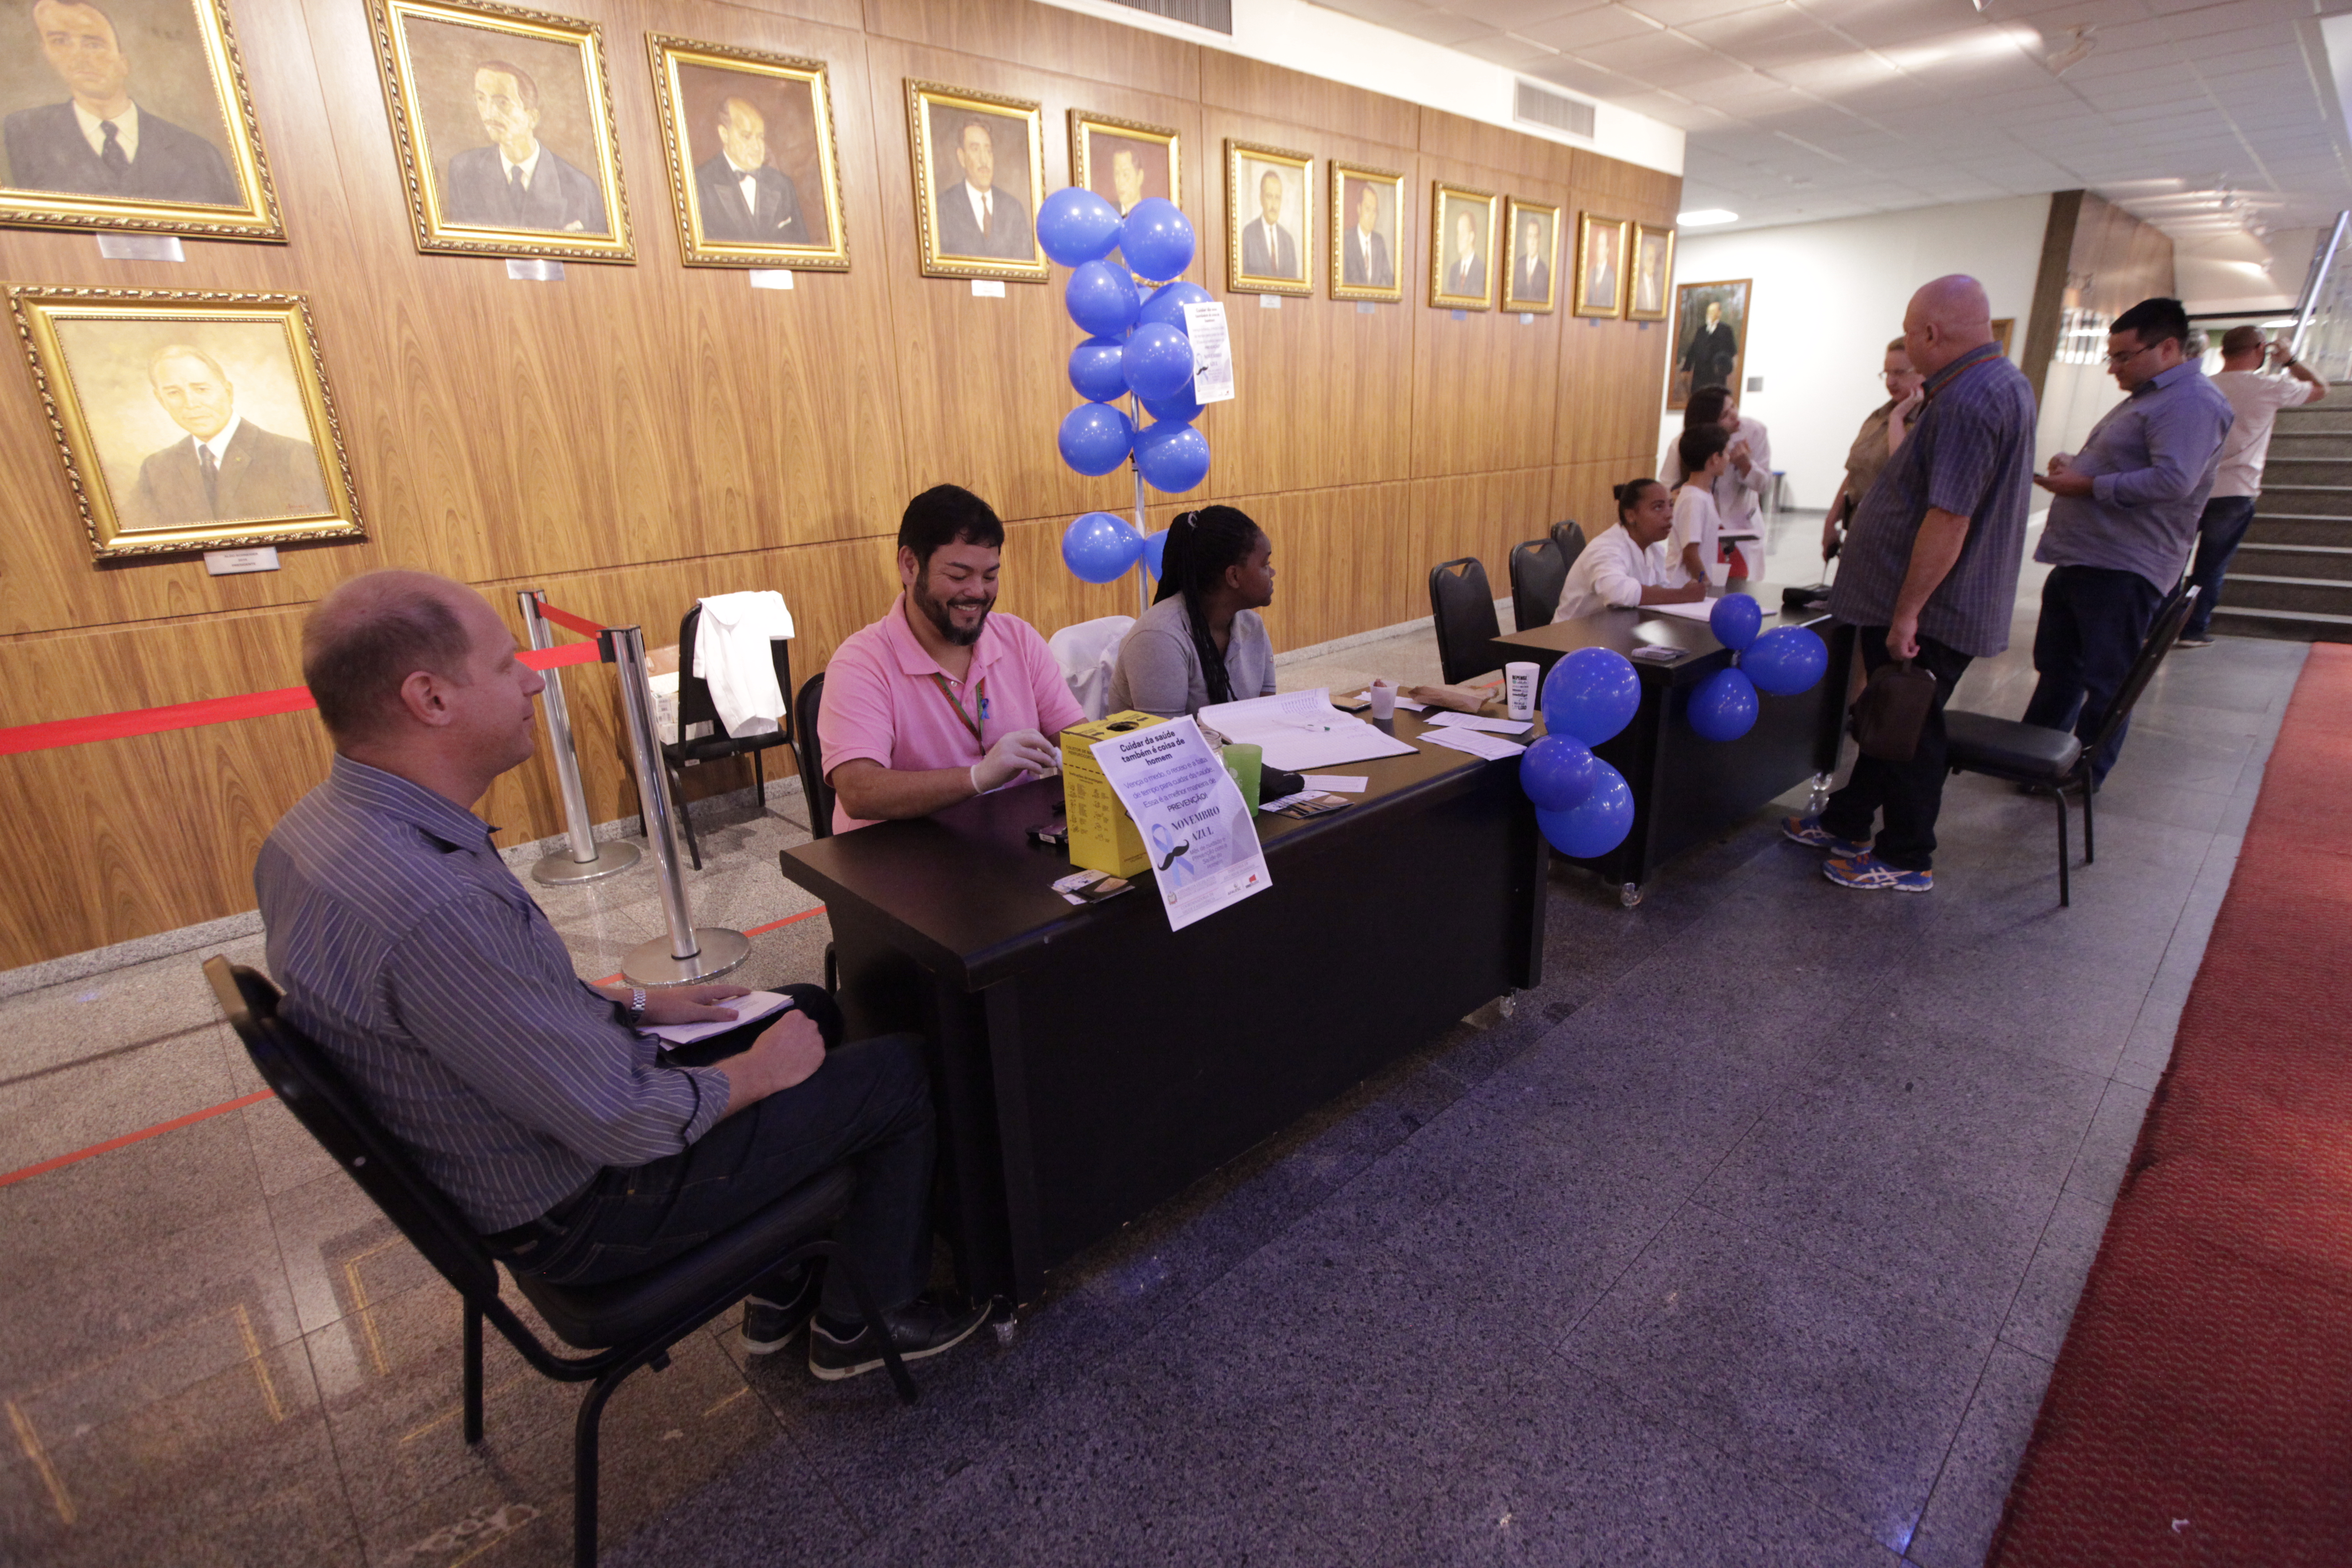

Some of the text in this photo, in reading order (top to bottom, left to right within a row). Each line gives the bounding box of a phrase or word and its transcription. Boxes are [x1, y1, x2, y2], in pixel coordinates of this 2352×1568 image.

[1120, 740, 1144, 752] Cuidar
[1155, 730, 1176, 742] saúde
[1121, 749, 1152, 763] também
[1158, 742, 1176, 751] coisa
[1176, 738, 1185, 746] de
[1145, 754, 1173, 766] homem
[1123, 779, 1145, 789] Vença
[1148, 772, 1167, 781] medo,
[1171, 764, 1188, 774] receio
[1195, 757, 1208, 765] falta
[1141, 786, 1160, 796] tempo
[1159, 781, 1173, 791] para
[1172, 775, 1189, 785] cuidar
[1197, 766, 1215, 776] saúde.
[1143, 799, 1159, 808] Essa
[1168, 787, 1187, 799] melhor
[1187, 781, 1209, 792] maneira
[1167, 792, 1209, 812] PREVENÇÃO!
[1171, 806, 1220, 831] NOVEMBRO
[1192, 826, 1214, 841] AZUL
